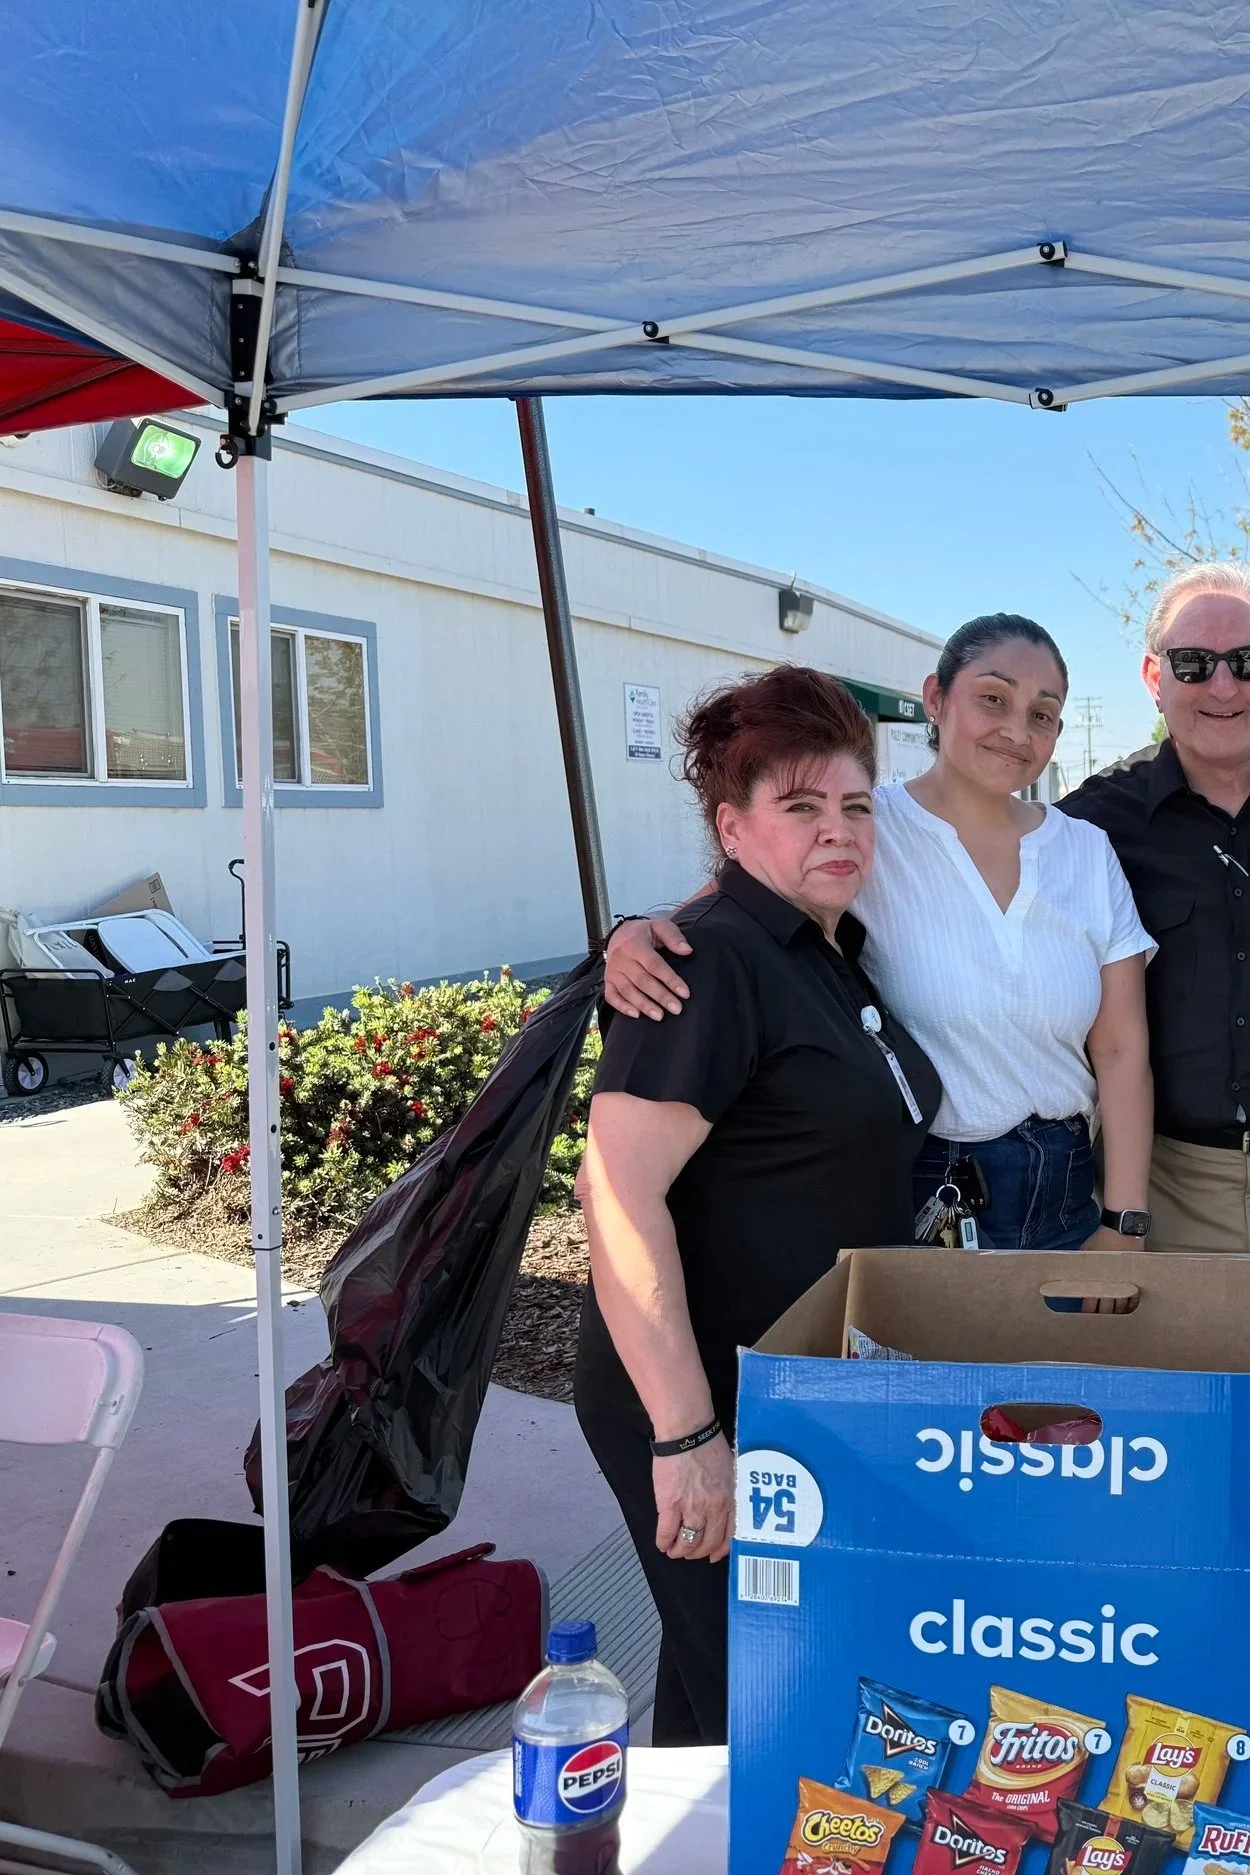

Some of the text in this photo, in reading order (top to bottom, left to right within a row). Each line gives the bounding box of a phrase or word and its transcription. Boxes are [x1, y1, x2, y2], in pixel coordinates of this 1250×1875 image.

[697, 1430, 714, 1442] SEEK
[916, 1428, 1168, 1495] classic
[750, 1471, 797, 1488] BAGS
[750, 1487, 796, 1533] 54
[909, 1599, 1160, 1666] classic
[867, 1717, 937, 1756] Doritos
[957, 1725, 966, 1740] 7
[990, 1722, 1078, 1766] Fritos
[1094, 1734, 1103, 1749] 7
[1151, 1742, 1195, 1769] Lay's
[1236, 1740, 1245, 1756] 8
[563, 1759, 620, 1791] PEPSI
[1150, 1779, 1176, 1792] CLASSIC
[991, 1790, 1050, 1805] The ORIGINAL
[803, 1811, 882, 1845] Cheetos
[822, 1842, 861, 1855] Crunchy
[934, 1825, 1007, 1864] Doritos
[1082, 1845, 1125, 1871] Lay's
